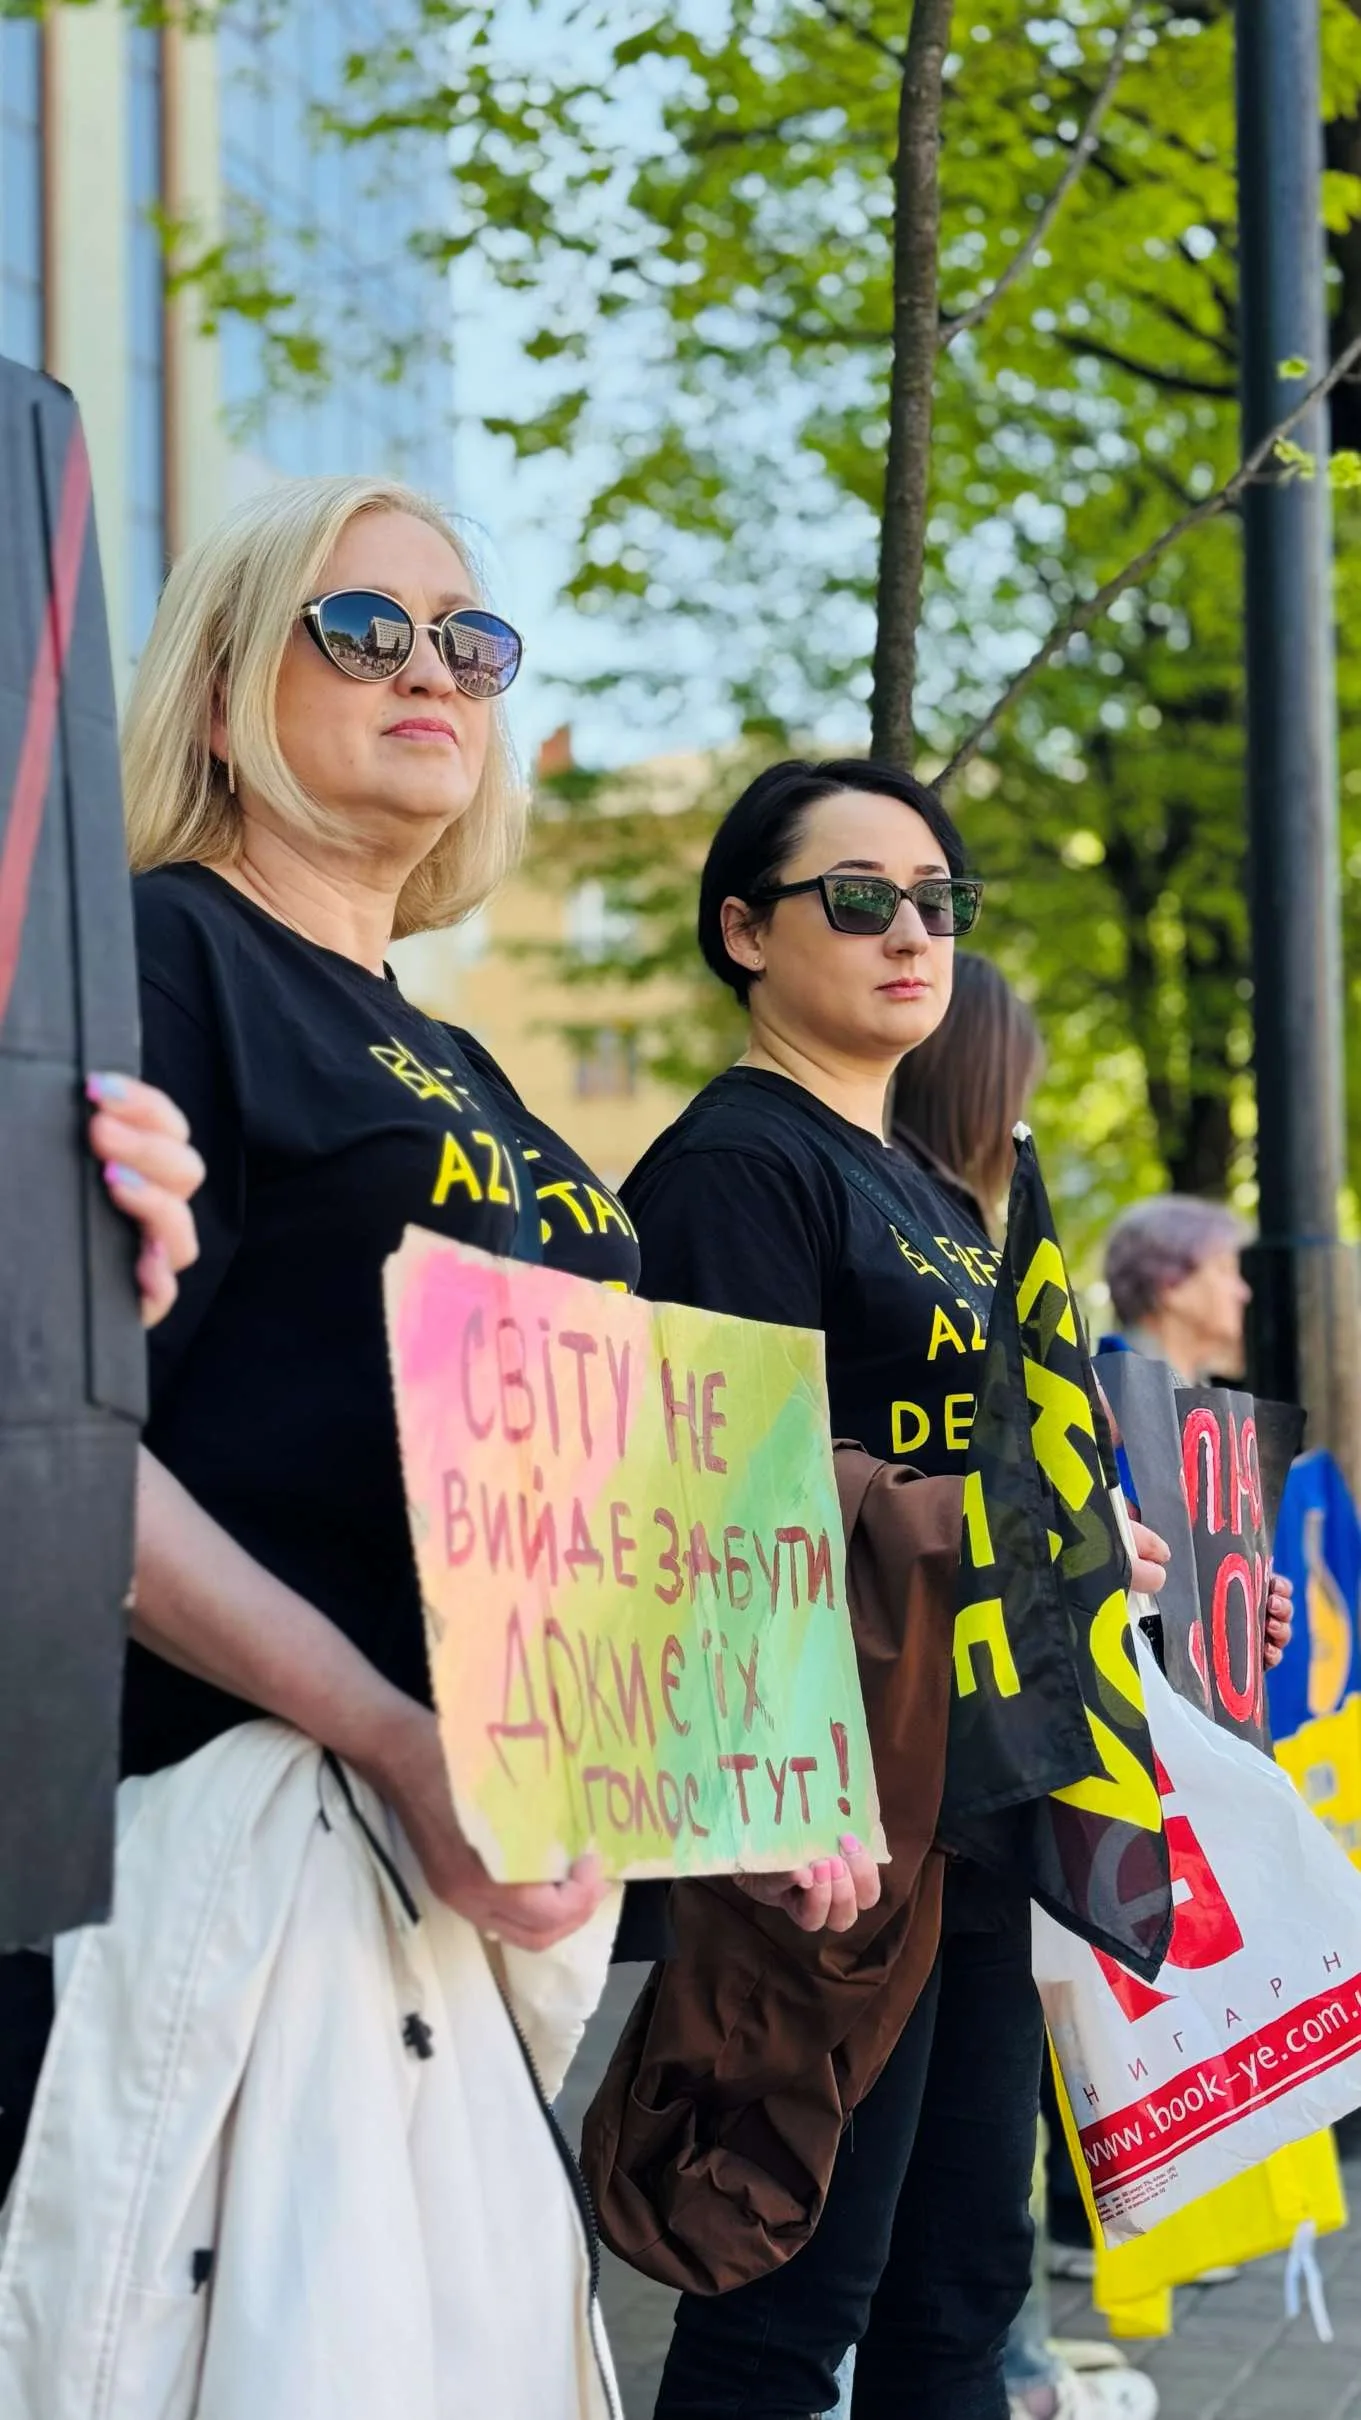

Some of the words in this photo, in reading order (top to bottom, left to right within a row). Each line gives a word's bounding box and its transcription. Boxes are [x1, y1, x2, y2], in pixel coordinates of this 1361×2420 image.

[660, 1357, 728, 1475] НЕ
[442, 1465, 638, 1588] ВИЙДЕ
[654, 1507, 834, 1615] ЗАБУТИ
[582, 1765, 710, 1839] ГОЛОС
